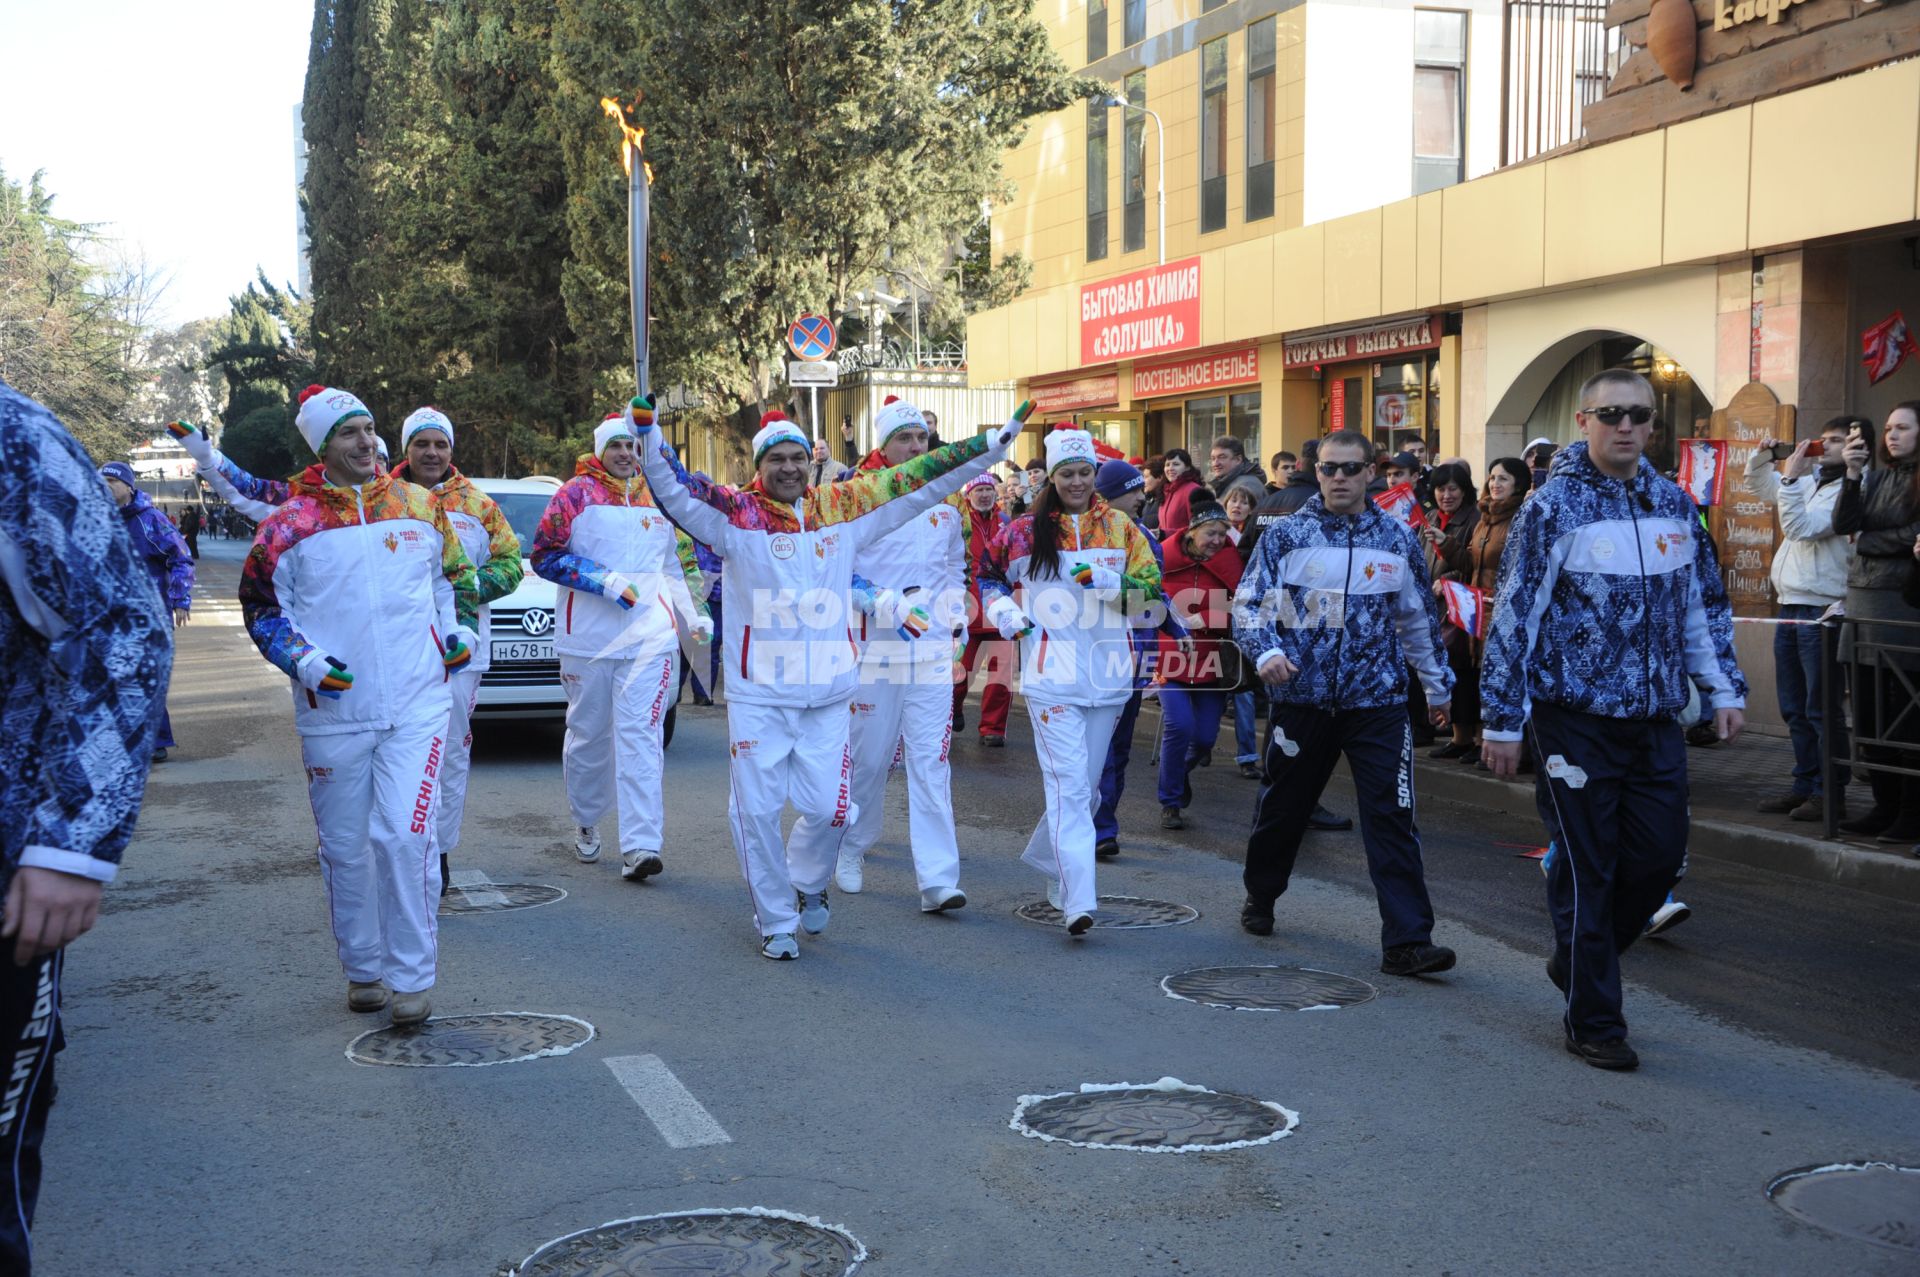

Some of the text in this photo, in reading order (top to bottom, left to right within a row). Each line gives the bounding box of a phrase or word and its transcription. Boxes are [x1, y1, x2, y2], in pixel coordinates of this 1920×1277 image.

[1082, 266, 1198, 322] БЫТОВАЯ ХИМИЯ
[1094, 314, 1185, 357] «ЗОЛУШКА»
[1135, 361, 1211, 393] ПОСТЕЛЬНОЕ
[1213, 350, 1256, 382] БЕЛЬЁ
[410, 736, 443, 835] SOCHI 2014
[831, 783, 848, 828] SOCHI
[1397, 762, 1411, 808] SOCHI
